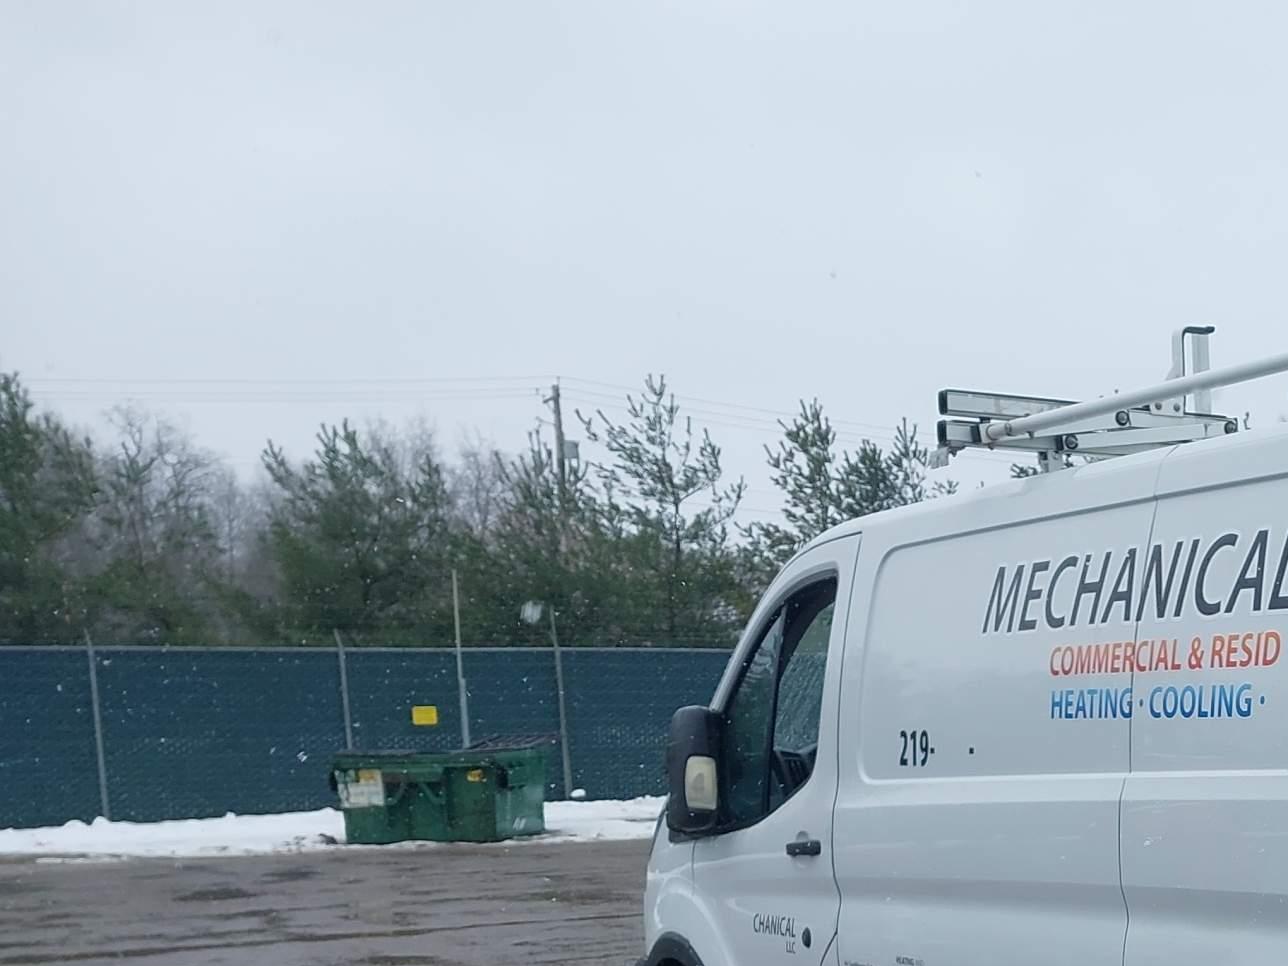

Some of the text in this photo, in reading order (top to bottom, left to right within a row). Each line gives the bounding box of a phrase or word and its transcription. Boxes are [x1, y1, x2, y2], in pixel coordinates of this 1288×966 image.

[1050, 631, 1281, 676] COMMERCIAL & RESID
[1050, 684, 1252, 720] HEATING COOLING
[753, 912, 796, 938] CHANICAL
[785, 941, 796, 954] LLC
